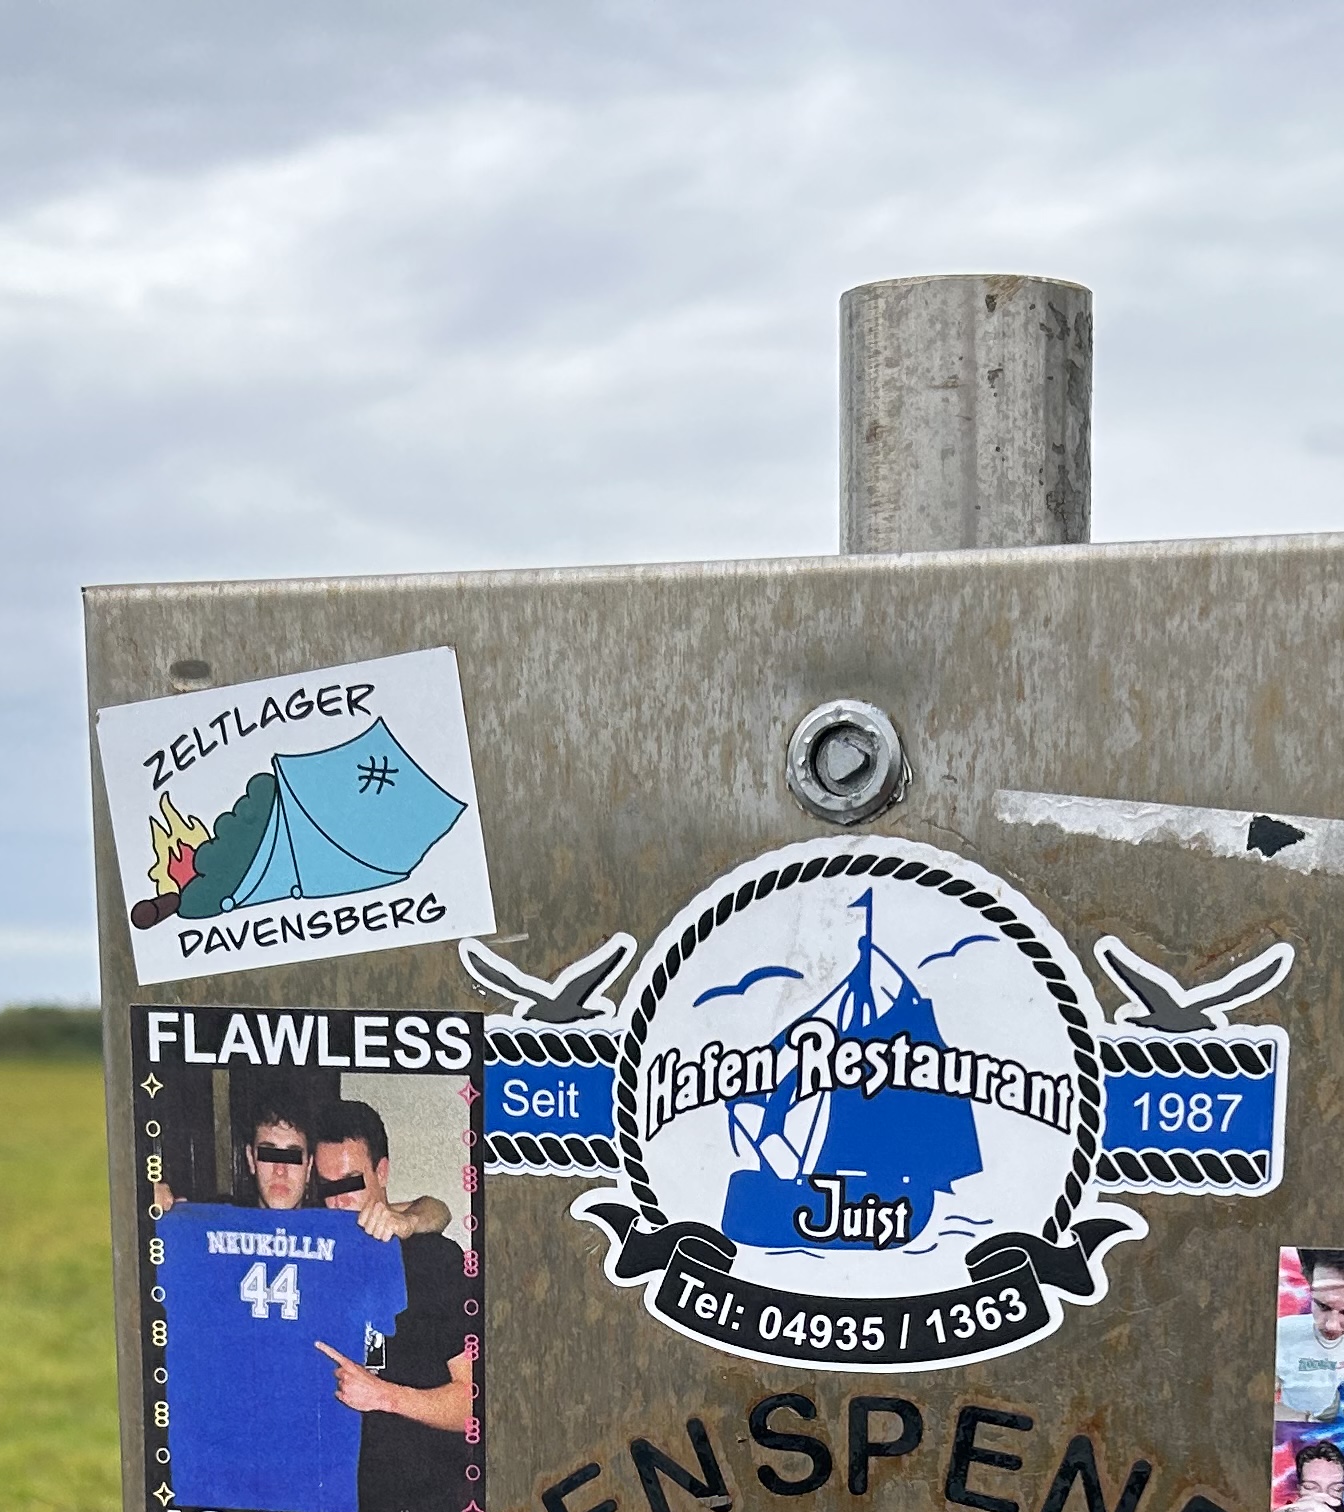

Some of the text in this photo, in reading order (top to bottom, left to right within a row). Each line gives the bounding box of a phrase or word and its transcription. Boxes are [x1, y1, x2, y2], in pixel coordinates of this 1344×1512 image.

[143, 684, 375, 791] ZELTLAGER
[178, 893, 447, 958] DAVENSBERG
[147, 1011, 473, 1070] FLAWLESS
[502, 1079, 580, 1119] Seit
[645, 1016, 1075, 1142] Hafen Restaurant
[1133, 1093, 1243, 1133] 1987
[793, 1174, 913, 1250] Juist
[206, 1228, 336, 1262] NEUKÖLLN
[239, 1262, 301, 1320] 44
[674, 1272, 744, 1332] Tel:
[758, 1305, 886, 1351] 04935
[925, 1287, 1028, 1344] 1363
